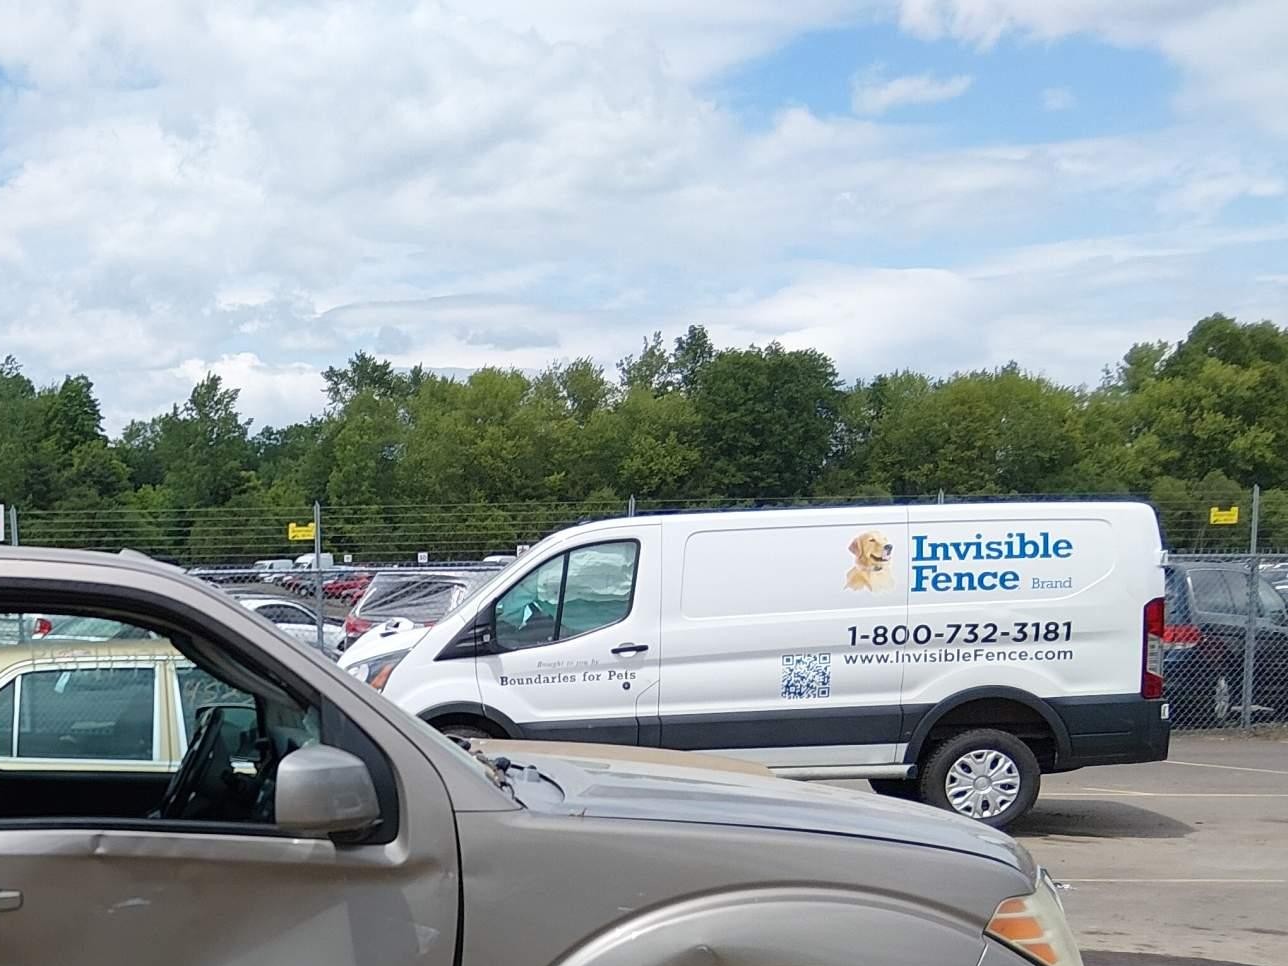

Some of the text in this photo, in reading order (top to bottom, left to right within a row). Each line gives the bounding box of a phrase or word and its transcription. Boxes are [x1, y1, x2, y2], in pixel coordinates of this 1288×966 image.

[911, 531, 1074, 562] Invisible
[911, 564, 1073, 593] Fence Brand
[847, 621, 1073, 647] 1-800-732-3181
[844, 648, 1074, 666] www.InvisibleFence.com
[500, 670, 637, 687] Boundaries for Pets
